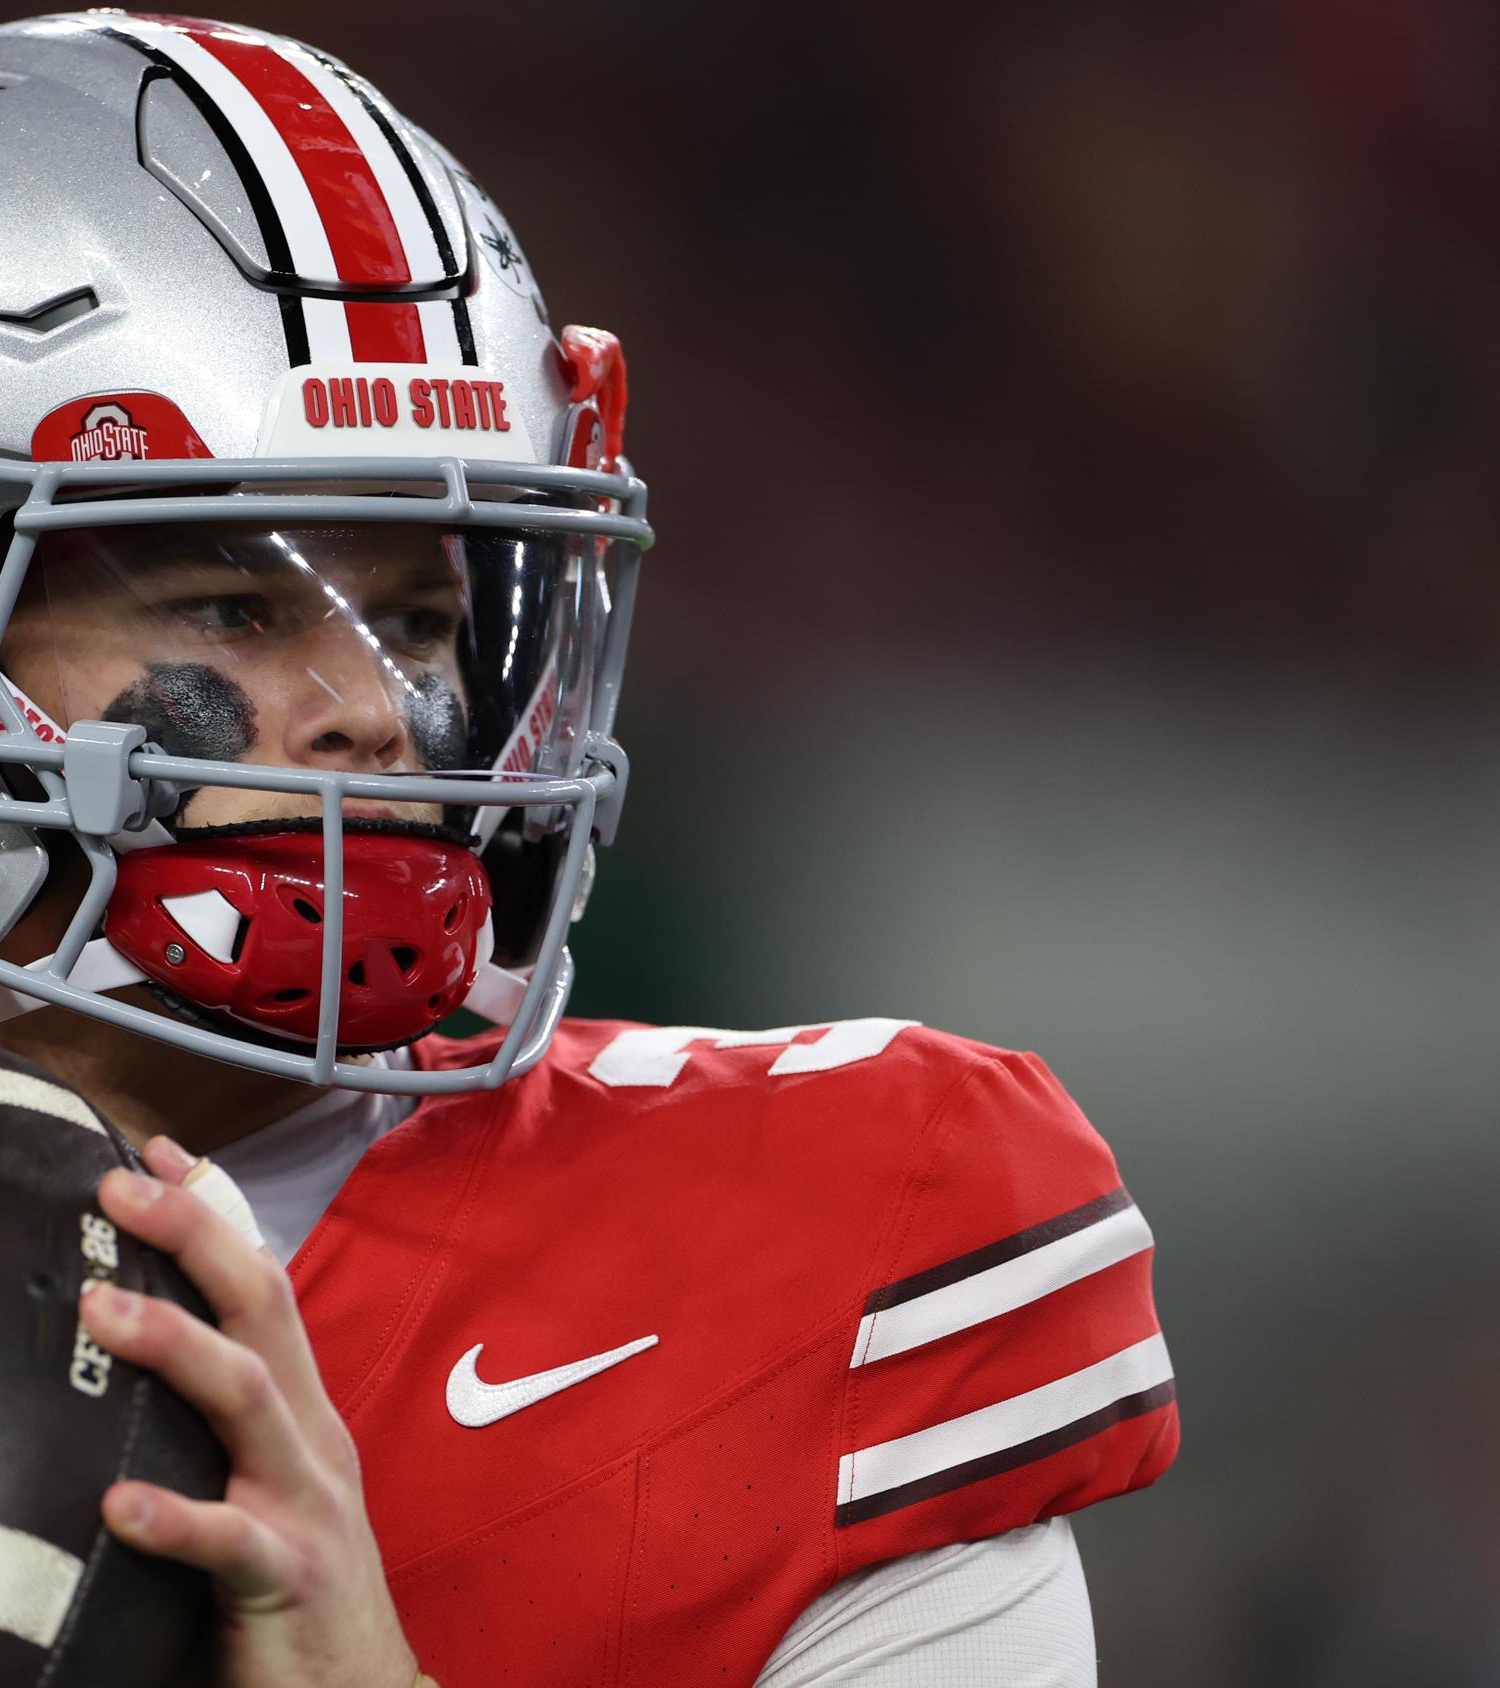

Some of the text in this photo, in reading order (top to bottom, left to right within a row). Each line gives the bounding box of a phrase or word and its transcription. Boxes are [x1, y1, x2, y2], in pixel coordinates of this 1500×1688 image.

[303, 378, 511, 432] OHIO STATE
[69, 1212, 119, 1397] CF 26
